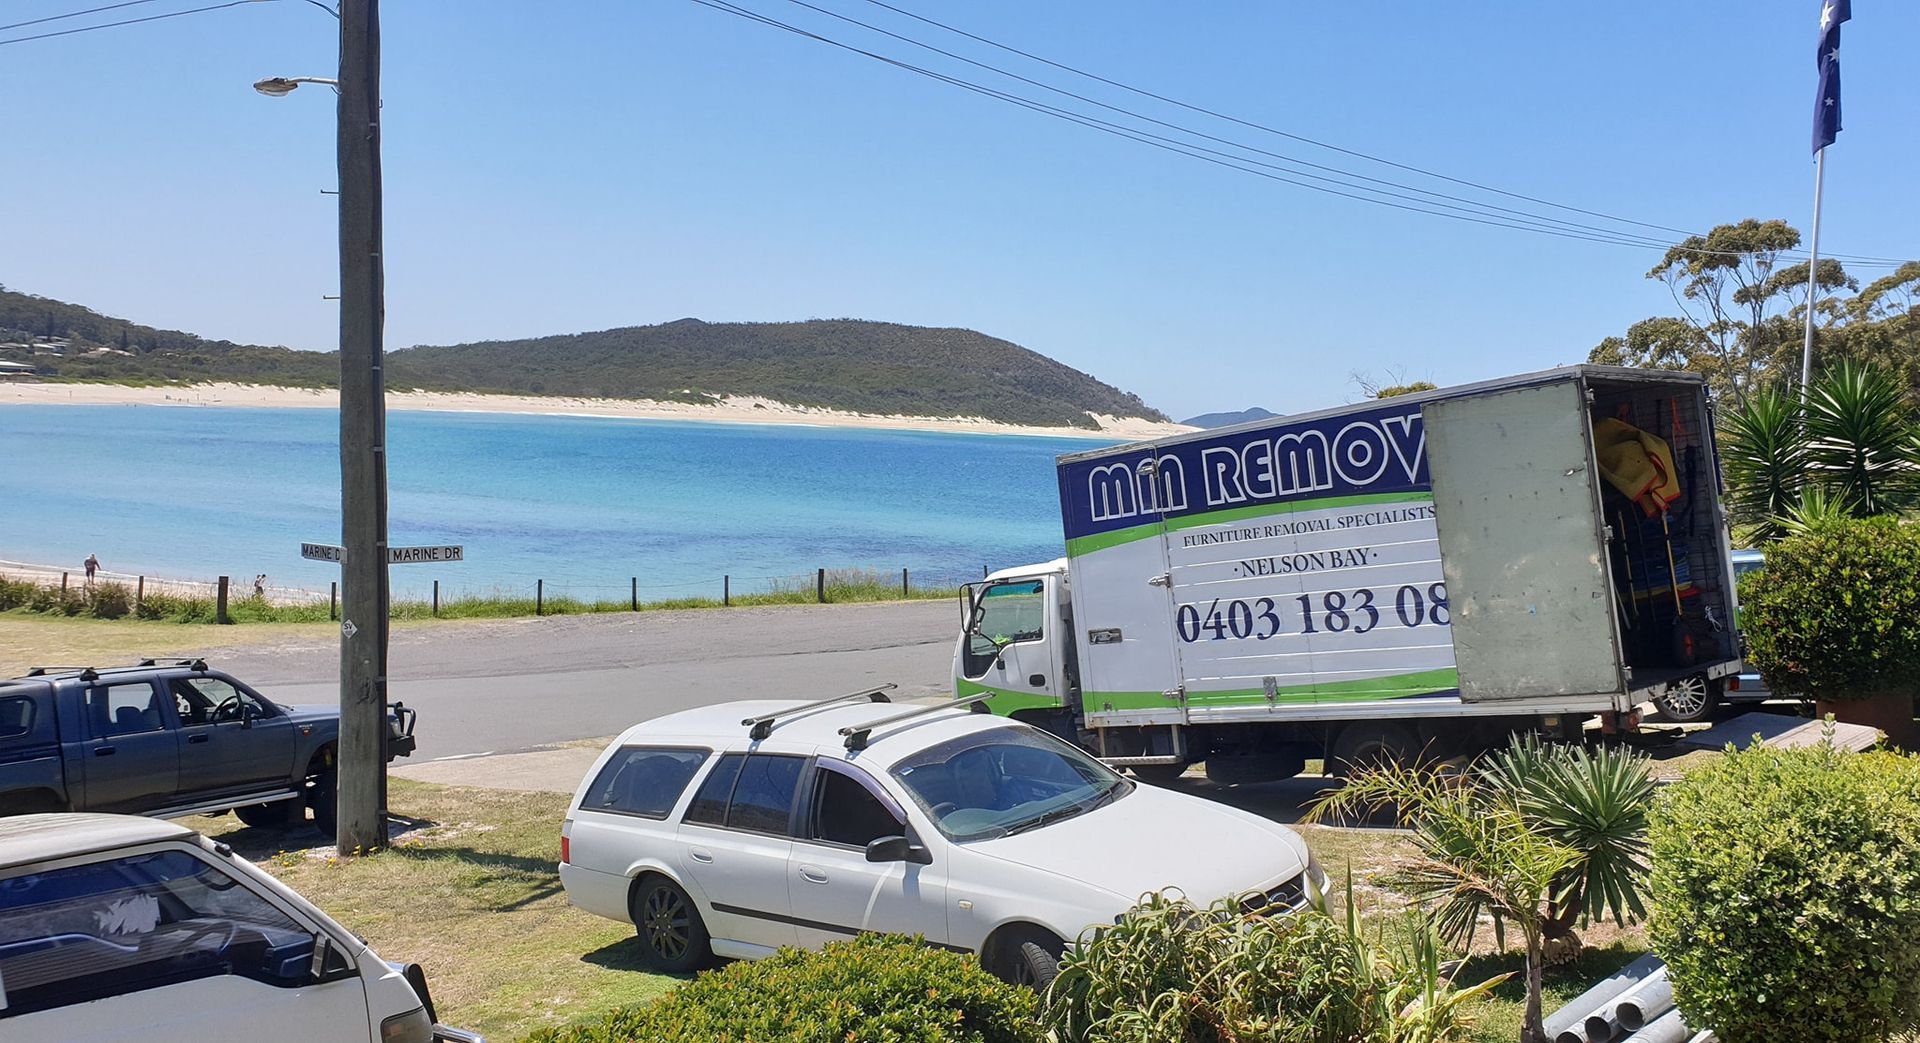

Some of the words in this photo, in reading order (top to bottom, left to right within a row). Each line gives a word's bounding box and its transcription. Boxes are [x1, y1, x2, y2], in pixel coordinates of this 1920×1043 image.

[1201, 413, 1425, 505] REMOV
[1183, 527, 1262, 547] FURNITURE
[1264, 520, 1335, 538] REMOVAL
[1337, 506, 1435, 529] SPECIALISTS
[304, 545, 332, 559] MARINE
[335, 549, 341, 560] D
[393, 548, 439, 561] MARINE
[445, 547, 460, 559] DR
[1177, 597, 1280, 643] 0403
[1296, 589, 1379, 634] 183
[1396, 582, 1450, 628] 08
